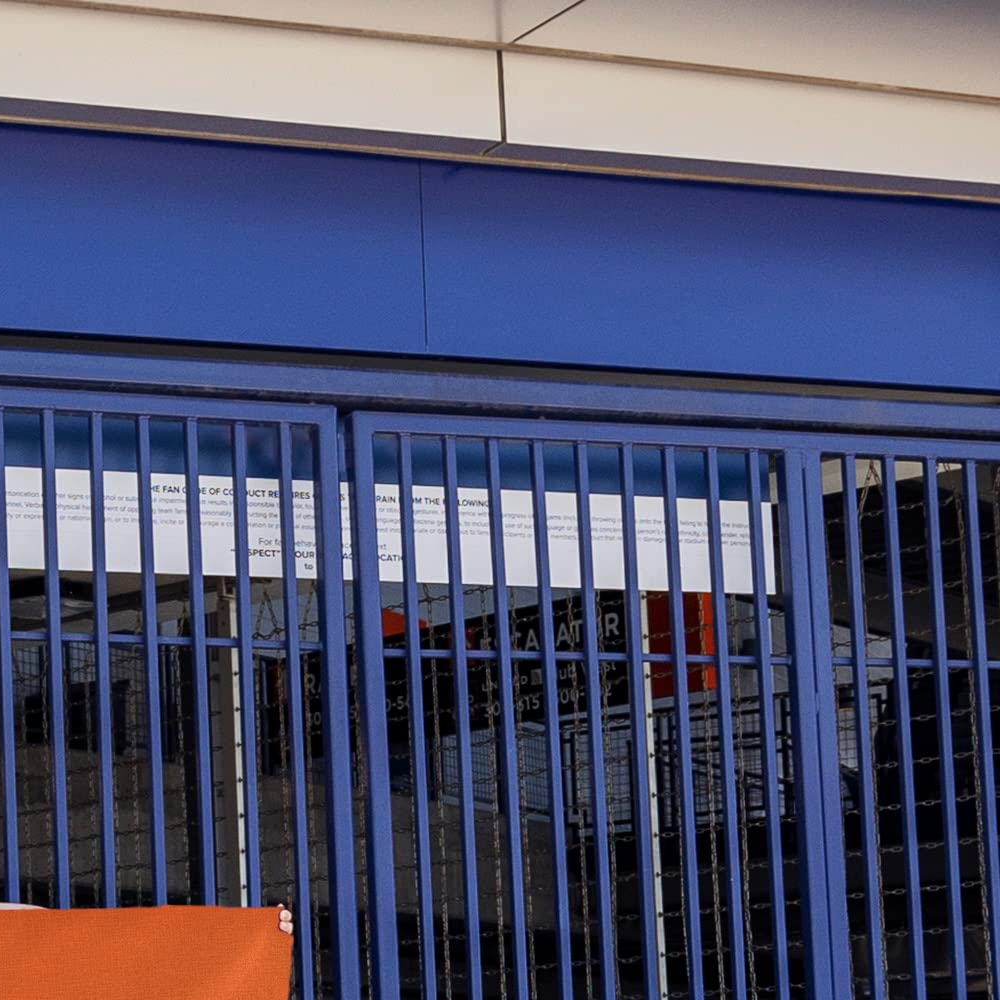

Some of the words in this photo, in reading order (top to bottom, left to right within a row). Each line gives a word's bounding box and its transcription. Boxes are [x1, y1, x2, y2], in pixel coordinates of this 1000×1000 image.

[162, 485, 180, 494] FAN
[208, 487, 221, 496] OF
[424, 497, 440, 506] THE
